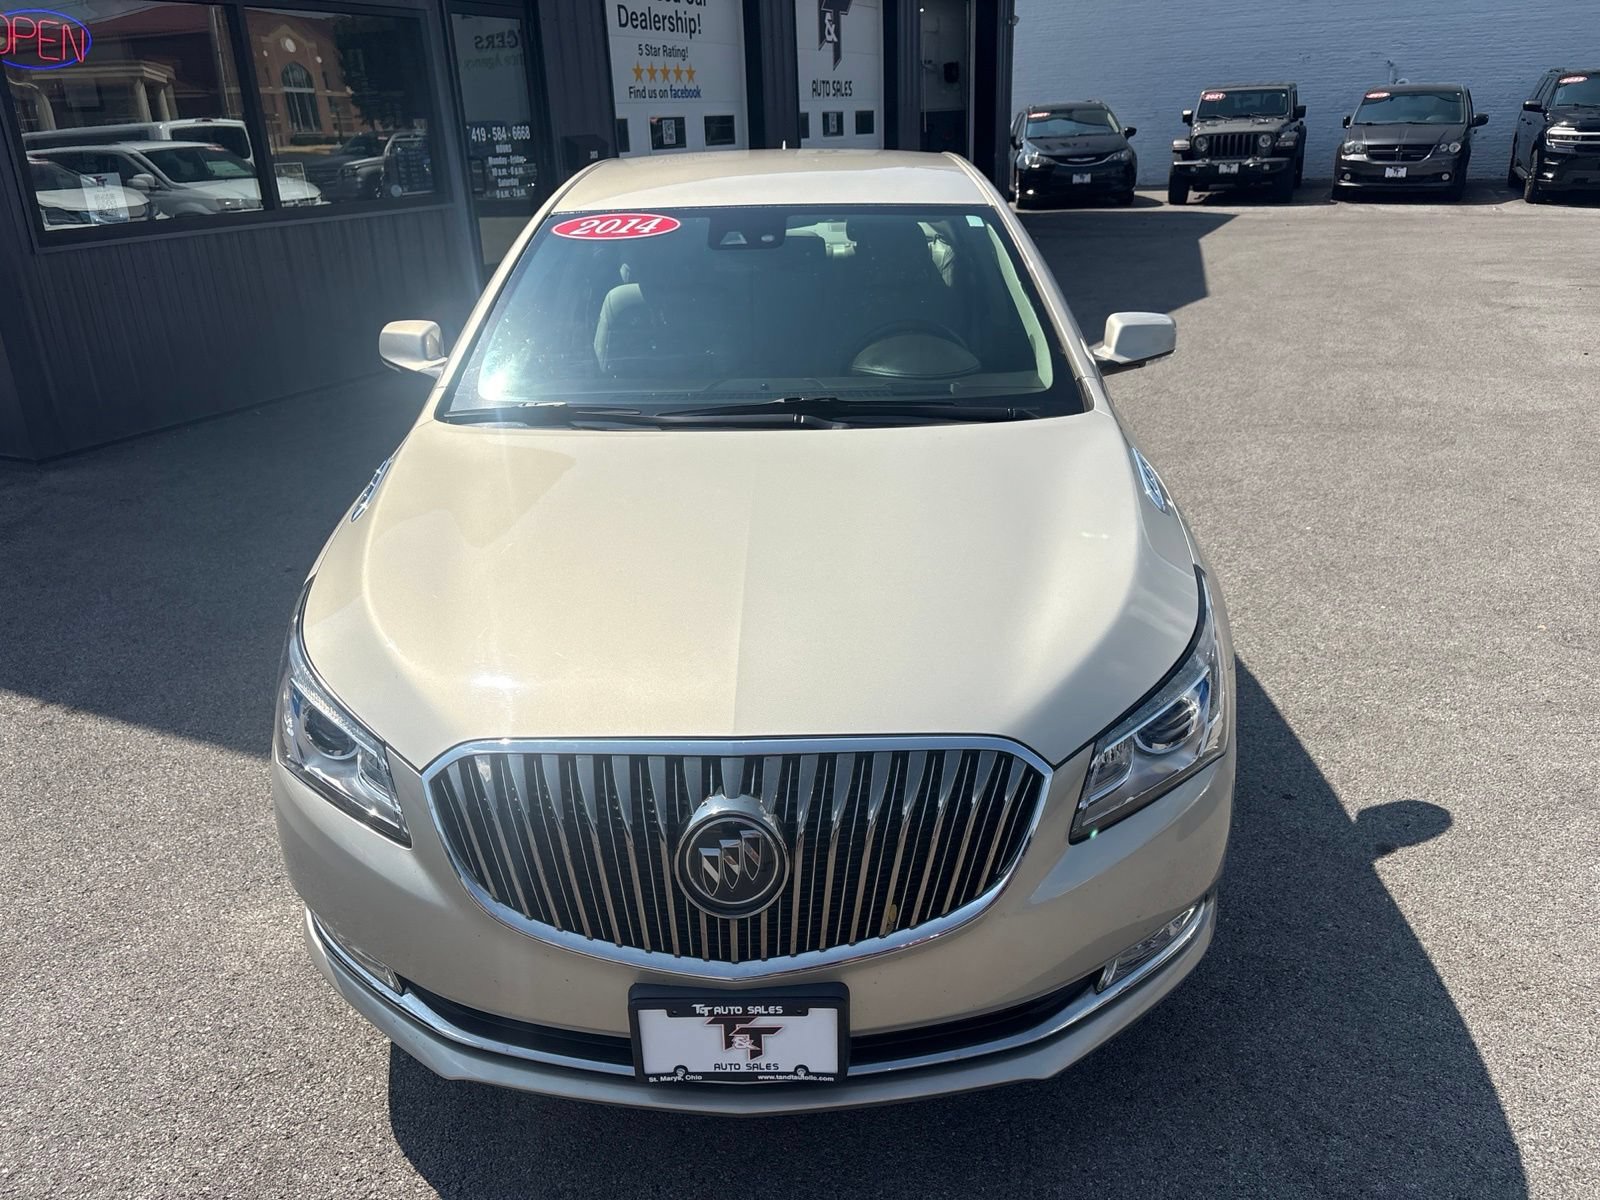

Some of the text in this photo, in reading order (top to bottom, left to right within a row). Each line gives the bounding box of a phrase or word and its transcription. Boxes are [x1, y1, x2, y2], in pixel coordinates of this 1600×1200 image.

[617, 4, 702, 39] Dealership!
[638, 43, 689, 61] 5 Star Rating!
[628, 84, 702, 99] Find us on facebook
[812, 79, 853, 98] AUTO SALES
[471, 127, 487, 142] 419
[492, 126, 507, 141] 584
[569, 217, 664, 235] 2014
[714, 1005, 743, 1015] AUTO
[747, 1005, 783, 1015] SALES
[704, 1016, 784, 1061] T&T
[714, 1063, 779, 1072] AUTO SALES
